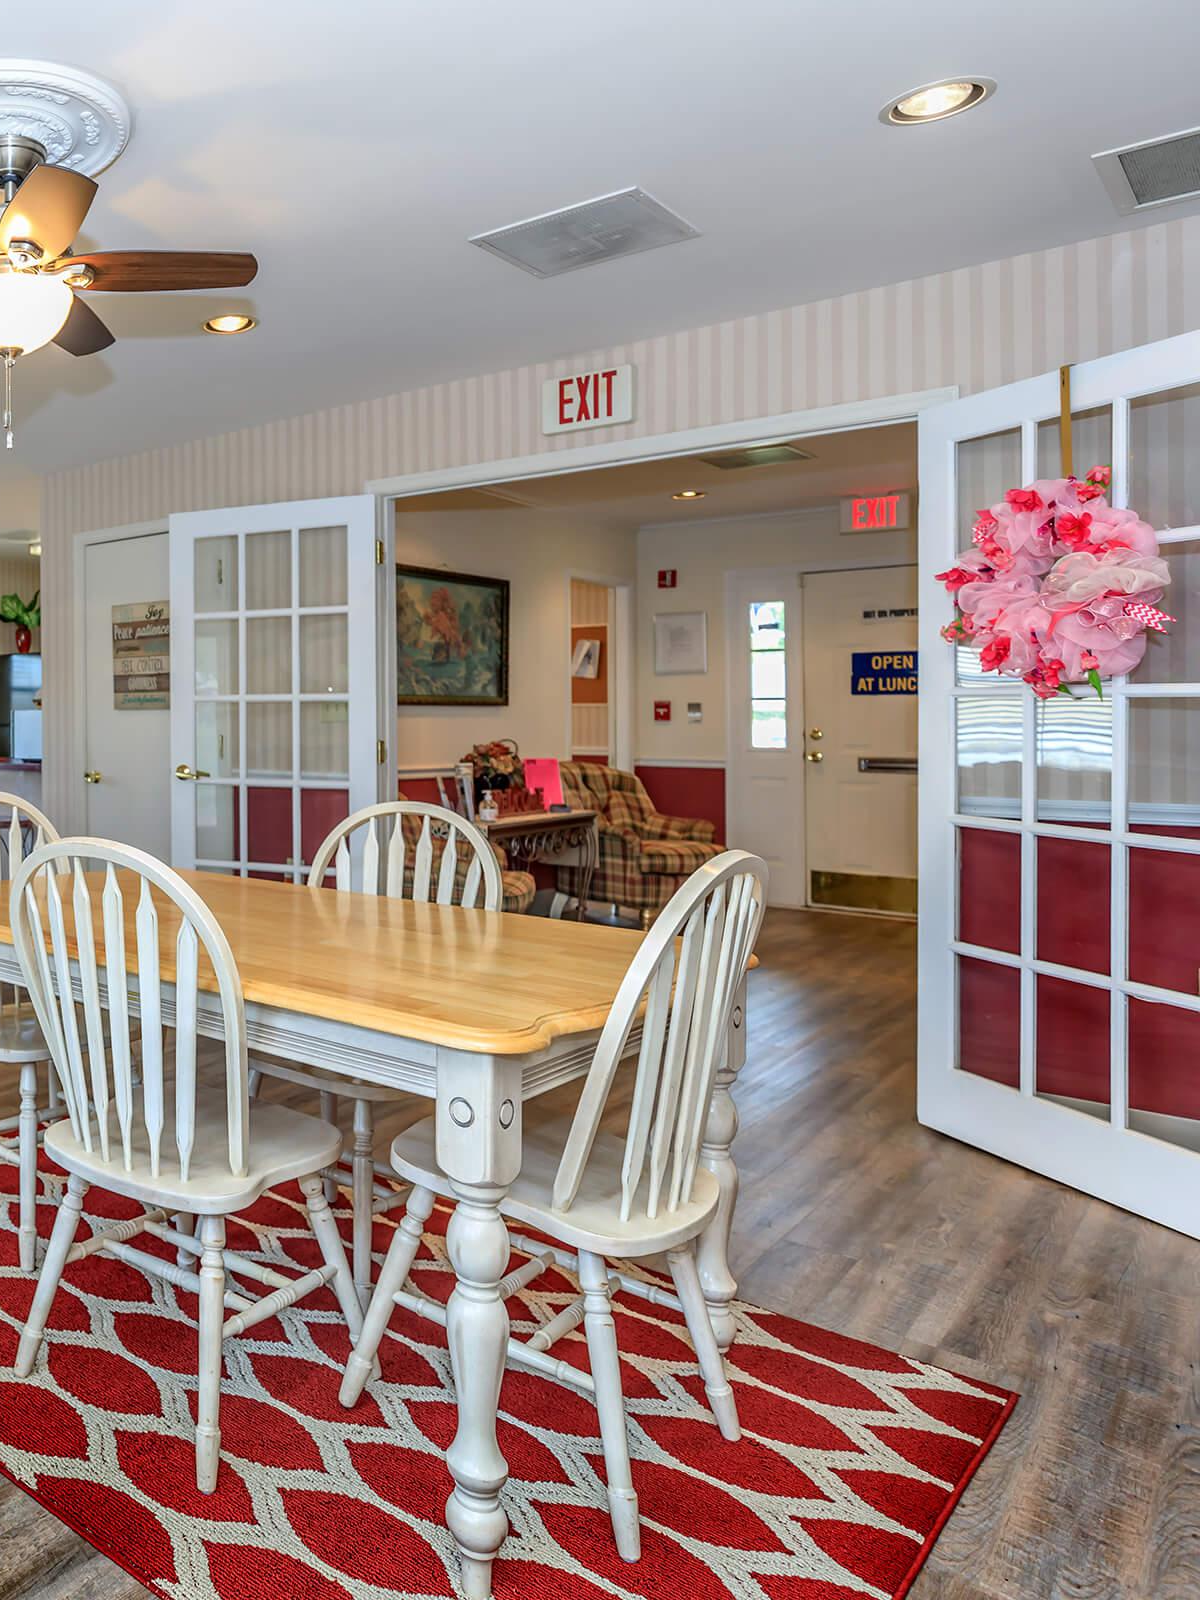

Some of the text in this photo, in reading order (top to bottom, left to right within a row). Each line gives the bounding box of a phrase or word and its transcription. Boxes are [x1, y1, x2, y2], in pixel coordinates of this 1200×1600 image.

[559, 369, 617, 425] EXIT
[851, 495, 900, 529] EXIT
[871, 655, 914, 670] OPEN
[857, 676, 918, 691] AT LUNC
